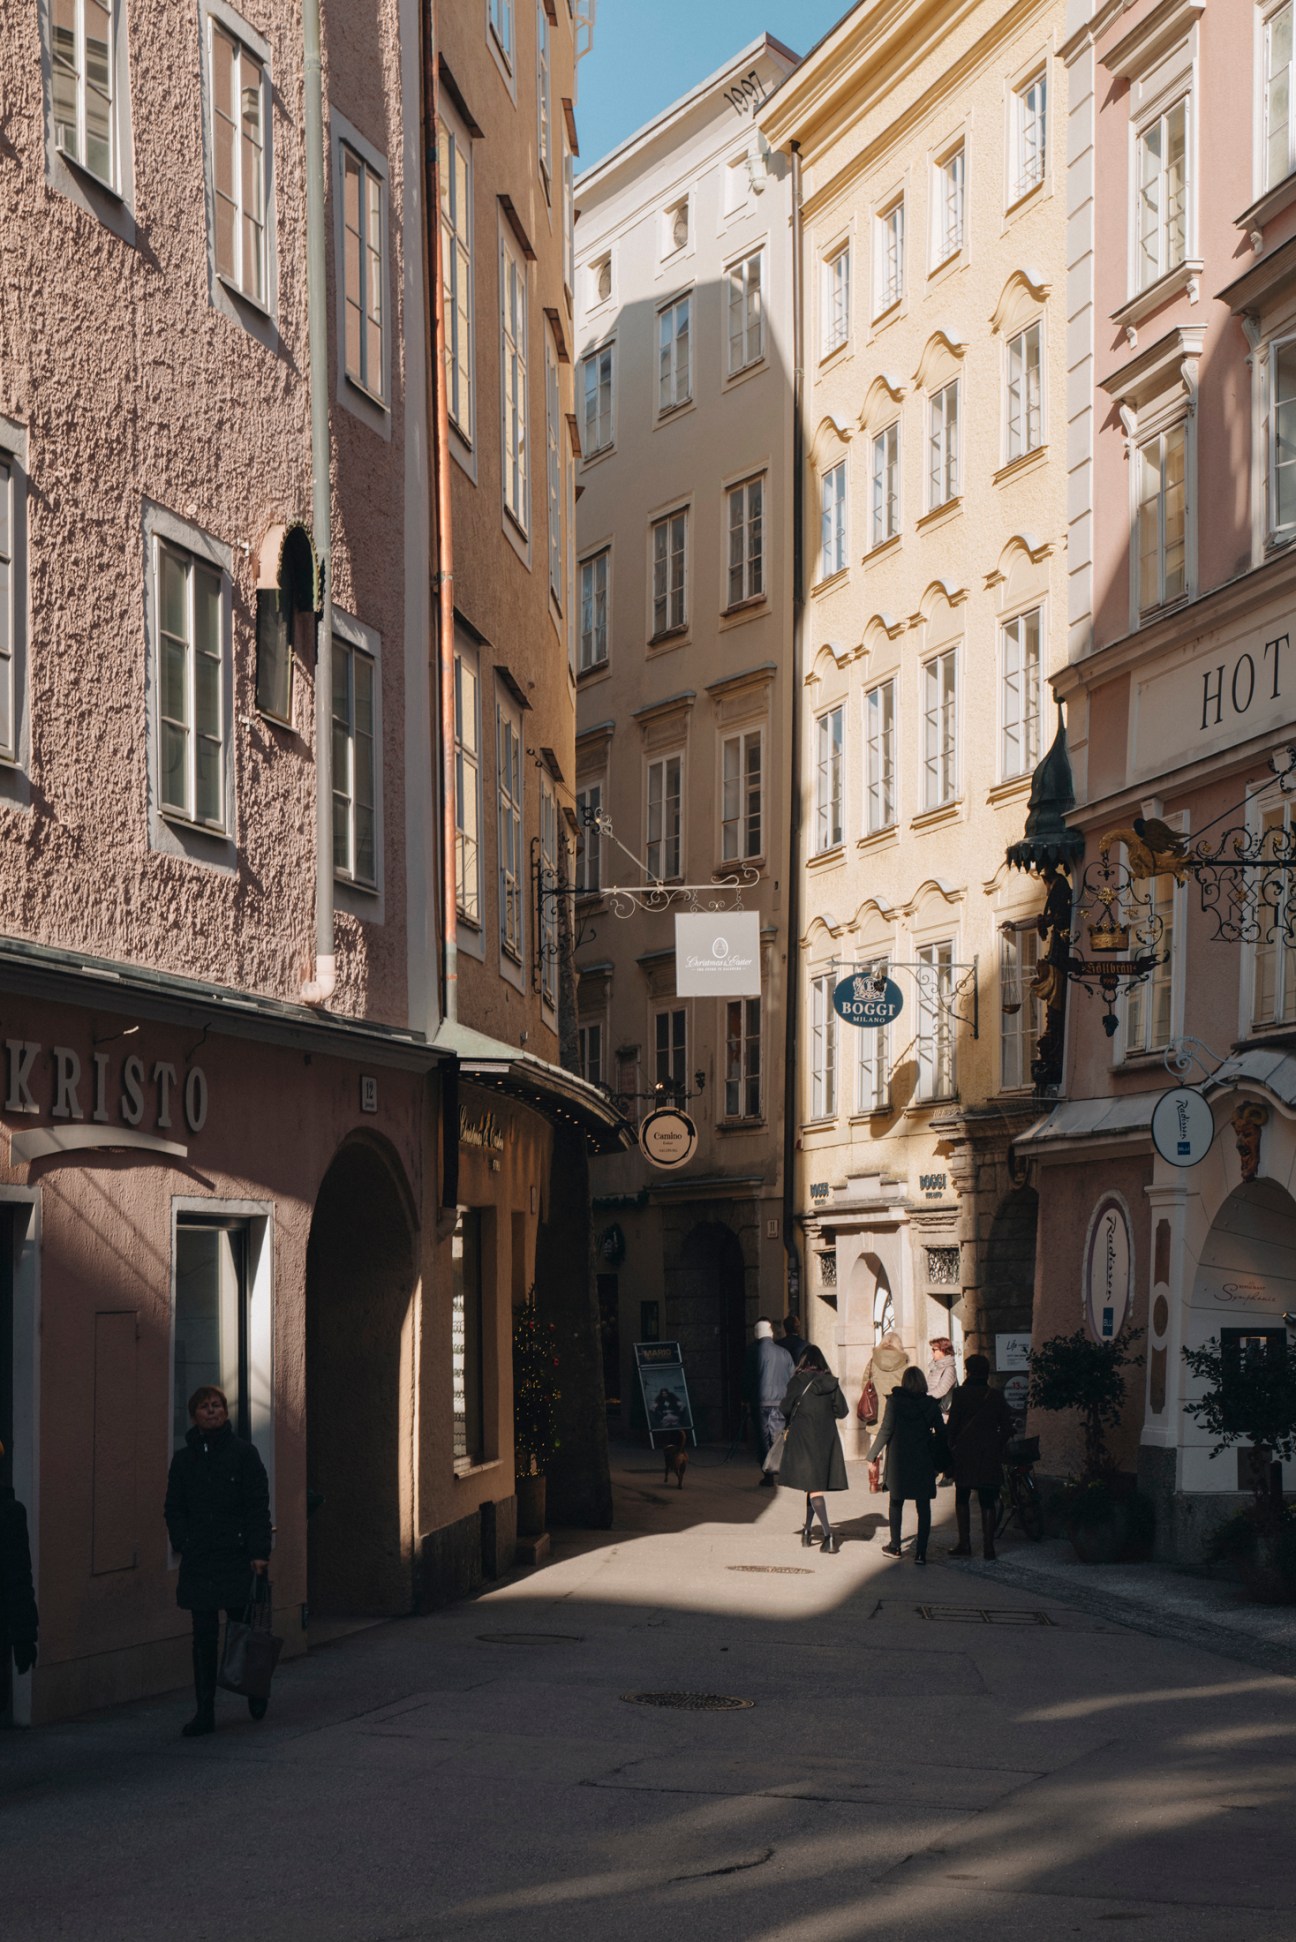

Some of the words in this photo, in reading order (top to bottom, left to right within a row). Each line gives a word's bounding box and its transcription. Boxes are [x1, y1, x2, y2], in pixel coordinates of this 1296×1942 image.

[723, 70, 766, 116] 1997
[1199, 631, 1290, 731] HOT
[842, 1001, 896, 1016] BOGGI
[853, 1016, 886, 1024] MILANO
[5, 1038, 209, 1132] KRISTO
[653, 1131, 683, 1140] Camino
[1176, 1100, 1190, 1140] Radisson
[1106, 1215, 1117, 1302] Radisson
